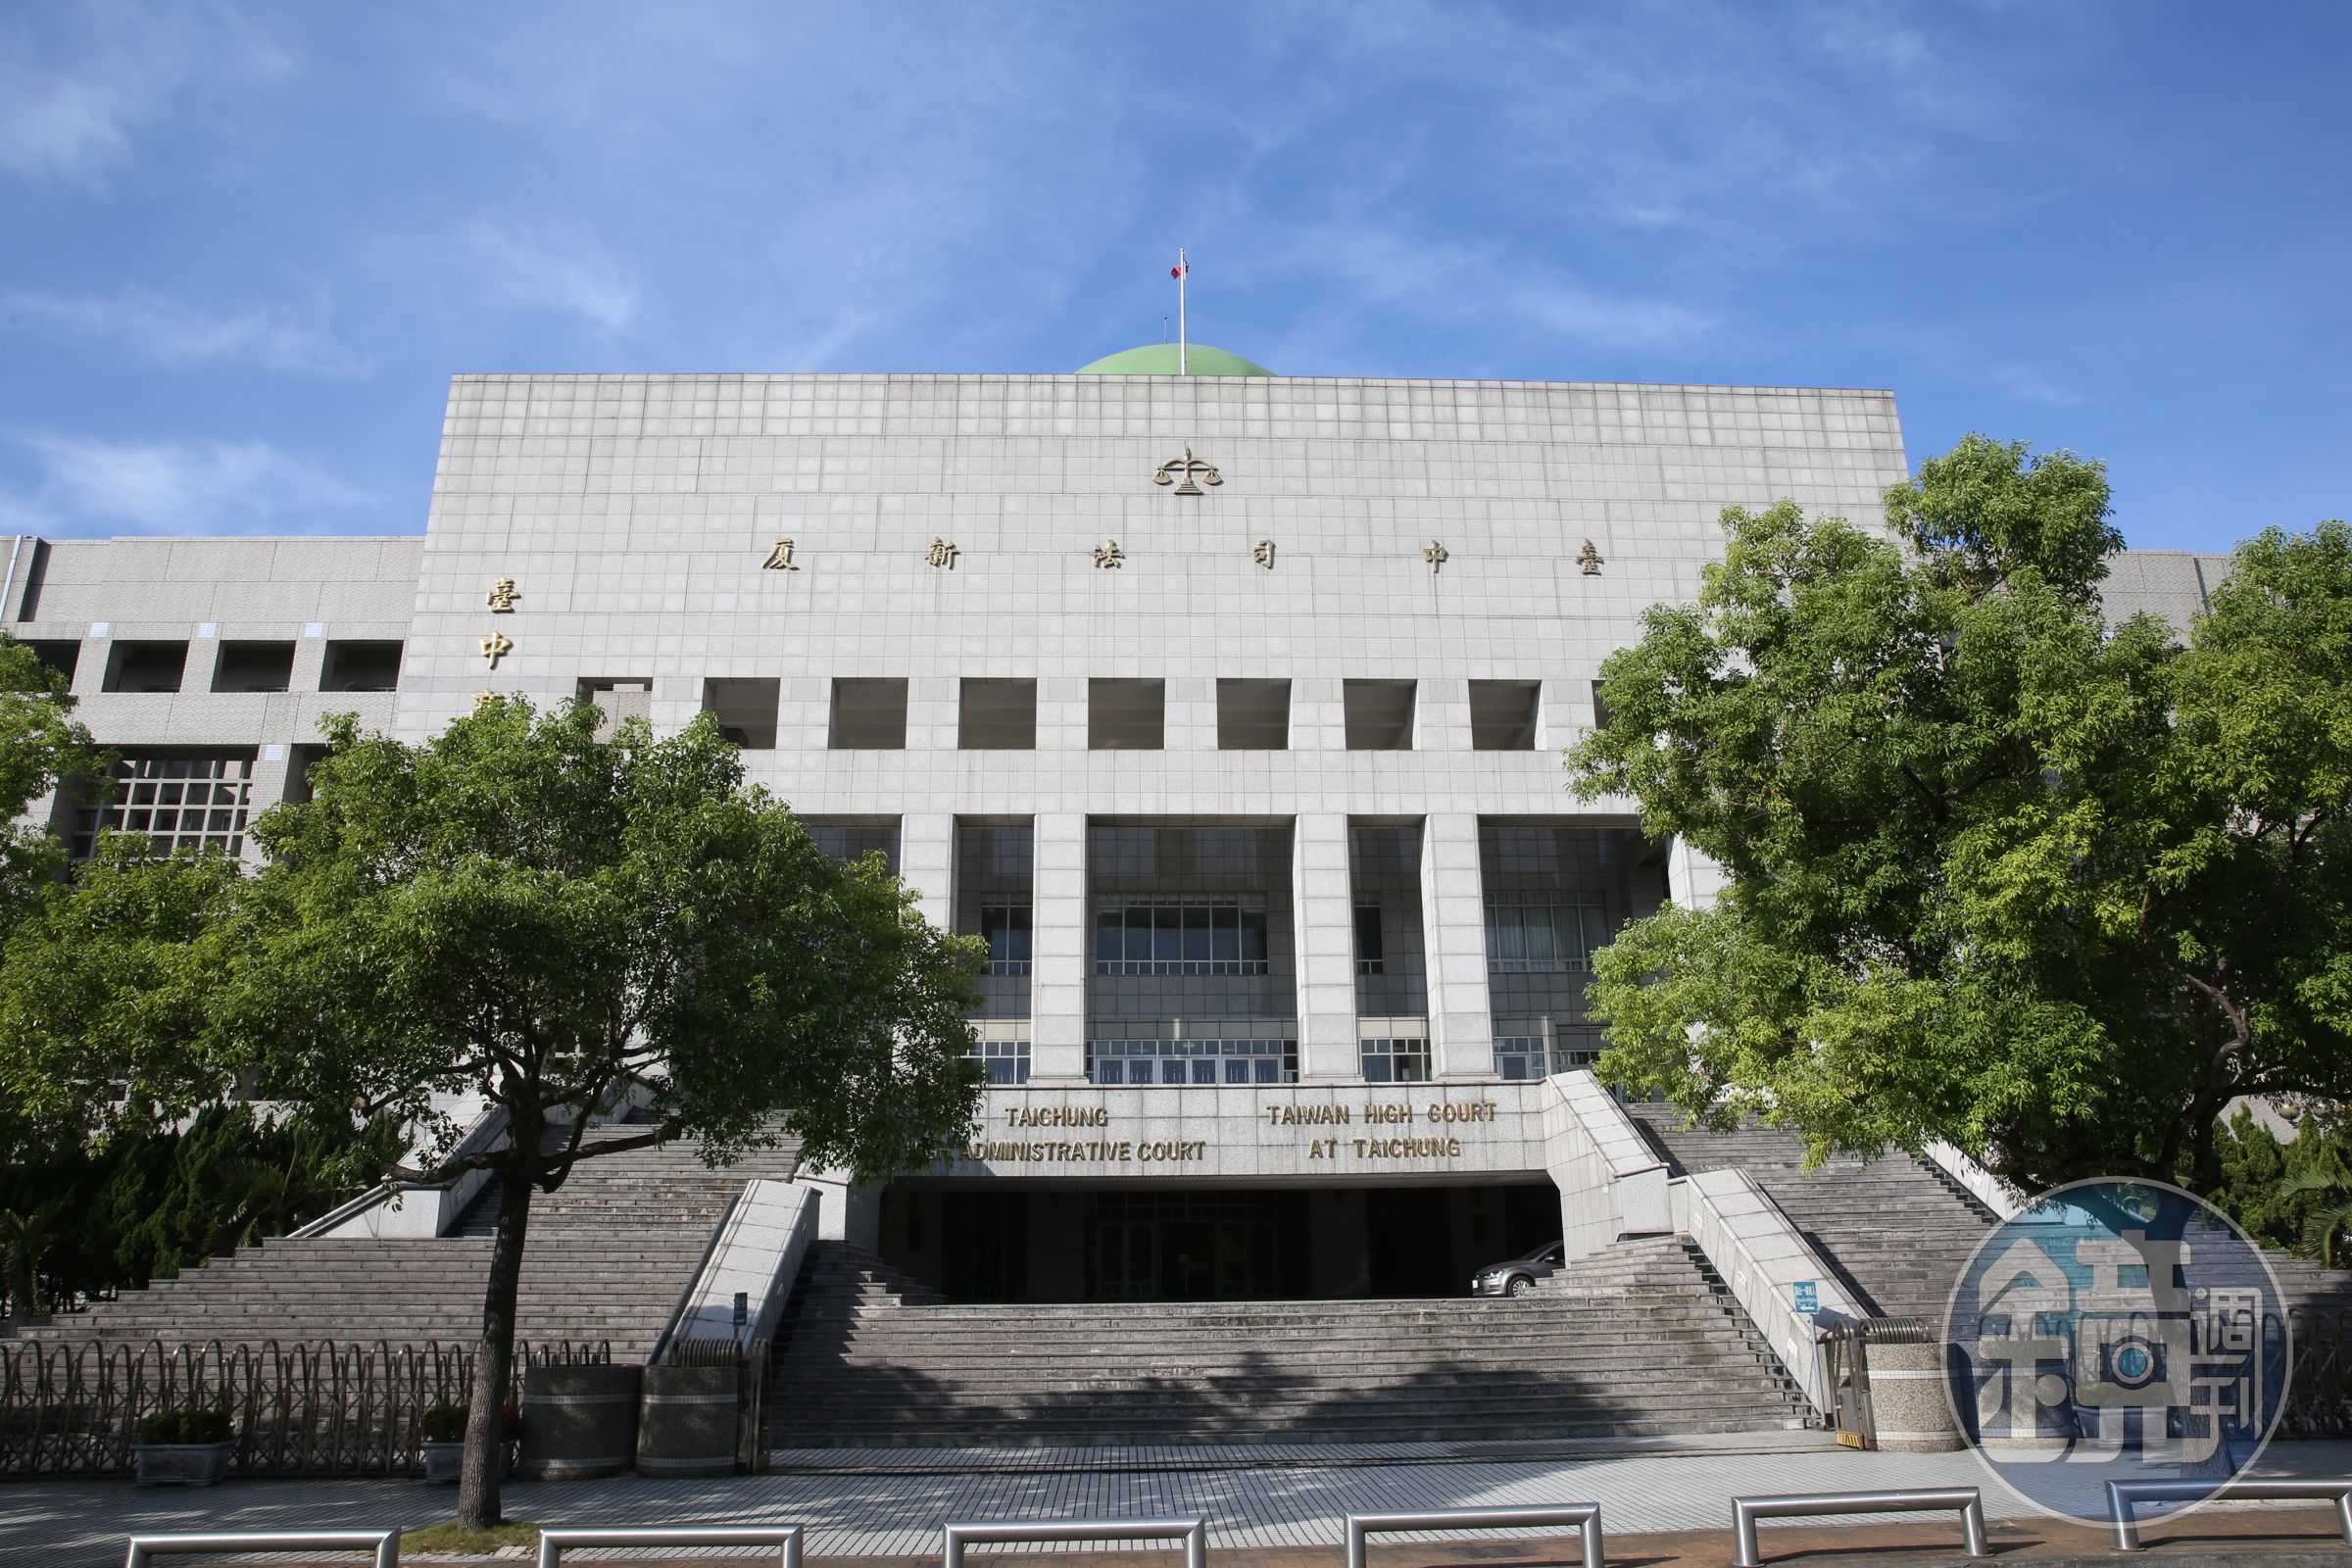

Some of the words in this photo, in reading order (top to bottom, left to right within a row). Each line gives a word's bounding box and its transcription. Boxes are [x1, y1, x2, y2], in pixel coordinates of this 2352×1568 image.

[1004, 1106, 1108, 1127] TAICHUNG
[1267, 1104, 1349, 1125] TAIWAN
[1363, 1103, 1412, 1124] HIGH
[1427, 1102, 1496, 1123] COURT
[959, 1140, 1131, 1161] ADMINISTRATIVE
[1136, 1140, 1205, 1161] COURT
[1309, 1138, 1337, 1158] AT
[1353, 1137, 1460, 1158] TAICHUNG
